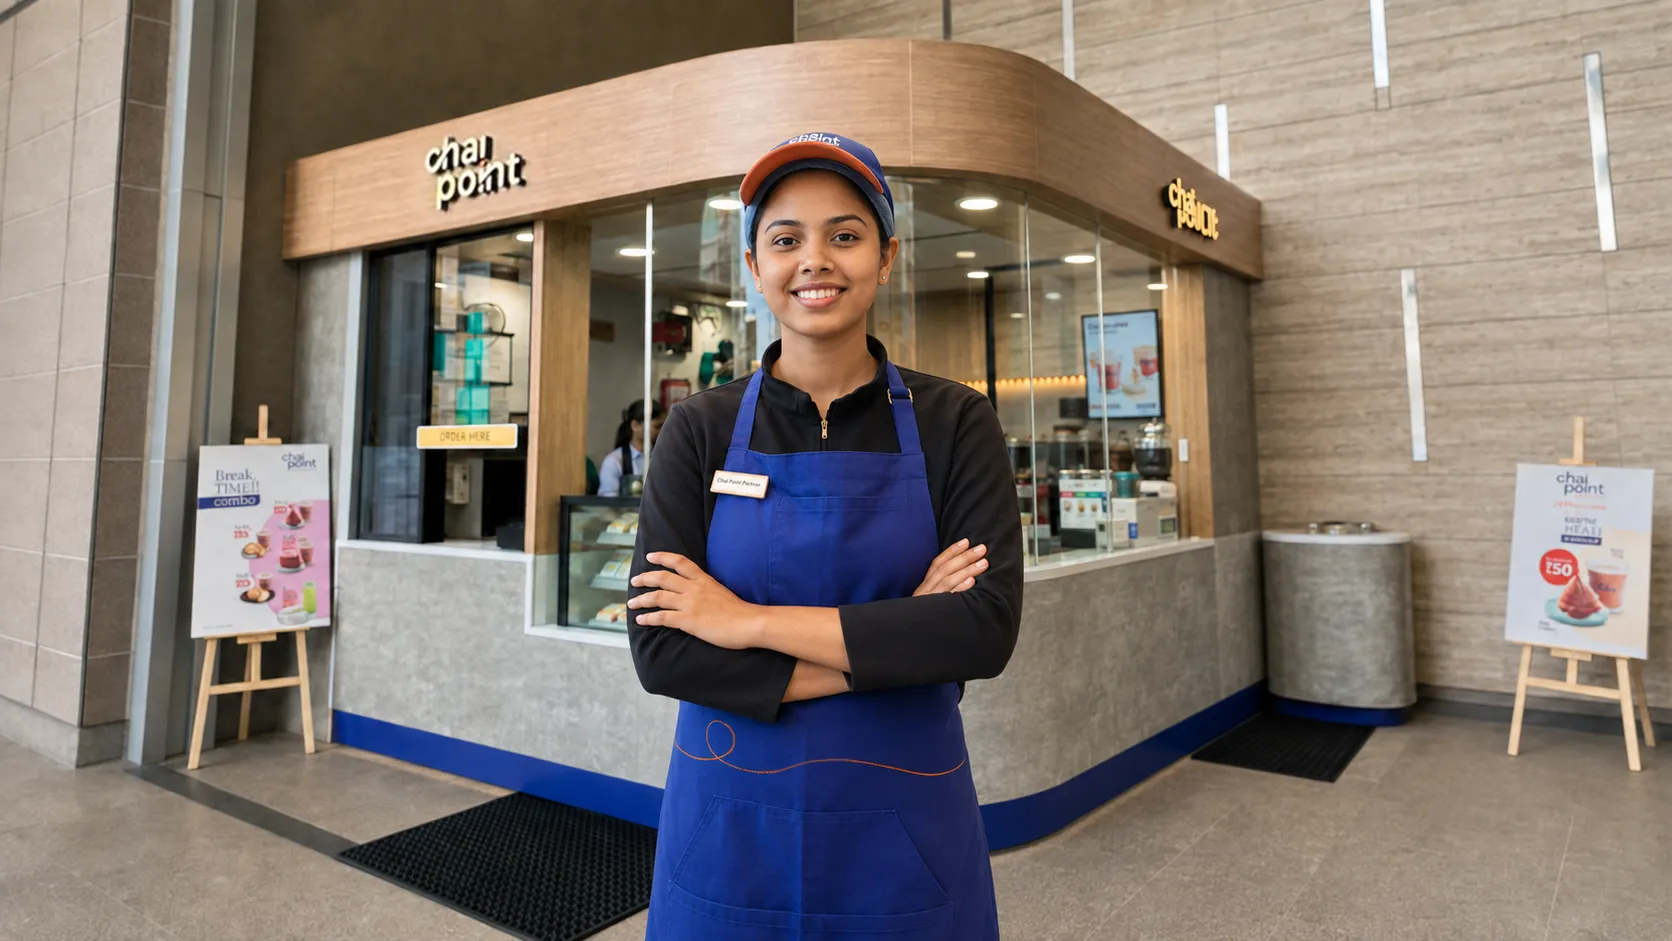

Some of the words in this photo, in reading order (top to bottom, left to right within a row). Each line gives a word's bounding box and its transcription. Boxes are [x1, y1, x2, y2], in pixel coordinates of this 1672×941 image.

[425, 135, 490, 174] chai
[436, 152, 521, 210] point
[439, 431, 467, 442] ORDER
[468, 430, 492, 442] HERE
[281, 452, 305, 464] chai
[287, 458, 317, 470] point
[1556, 471, 1589, 485] chai
[1564, 483, 1605, 496] point
[213, 495, 257, 508] combo
